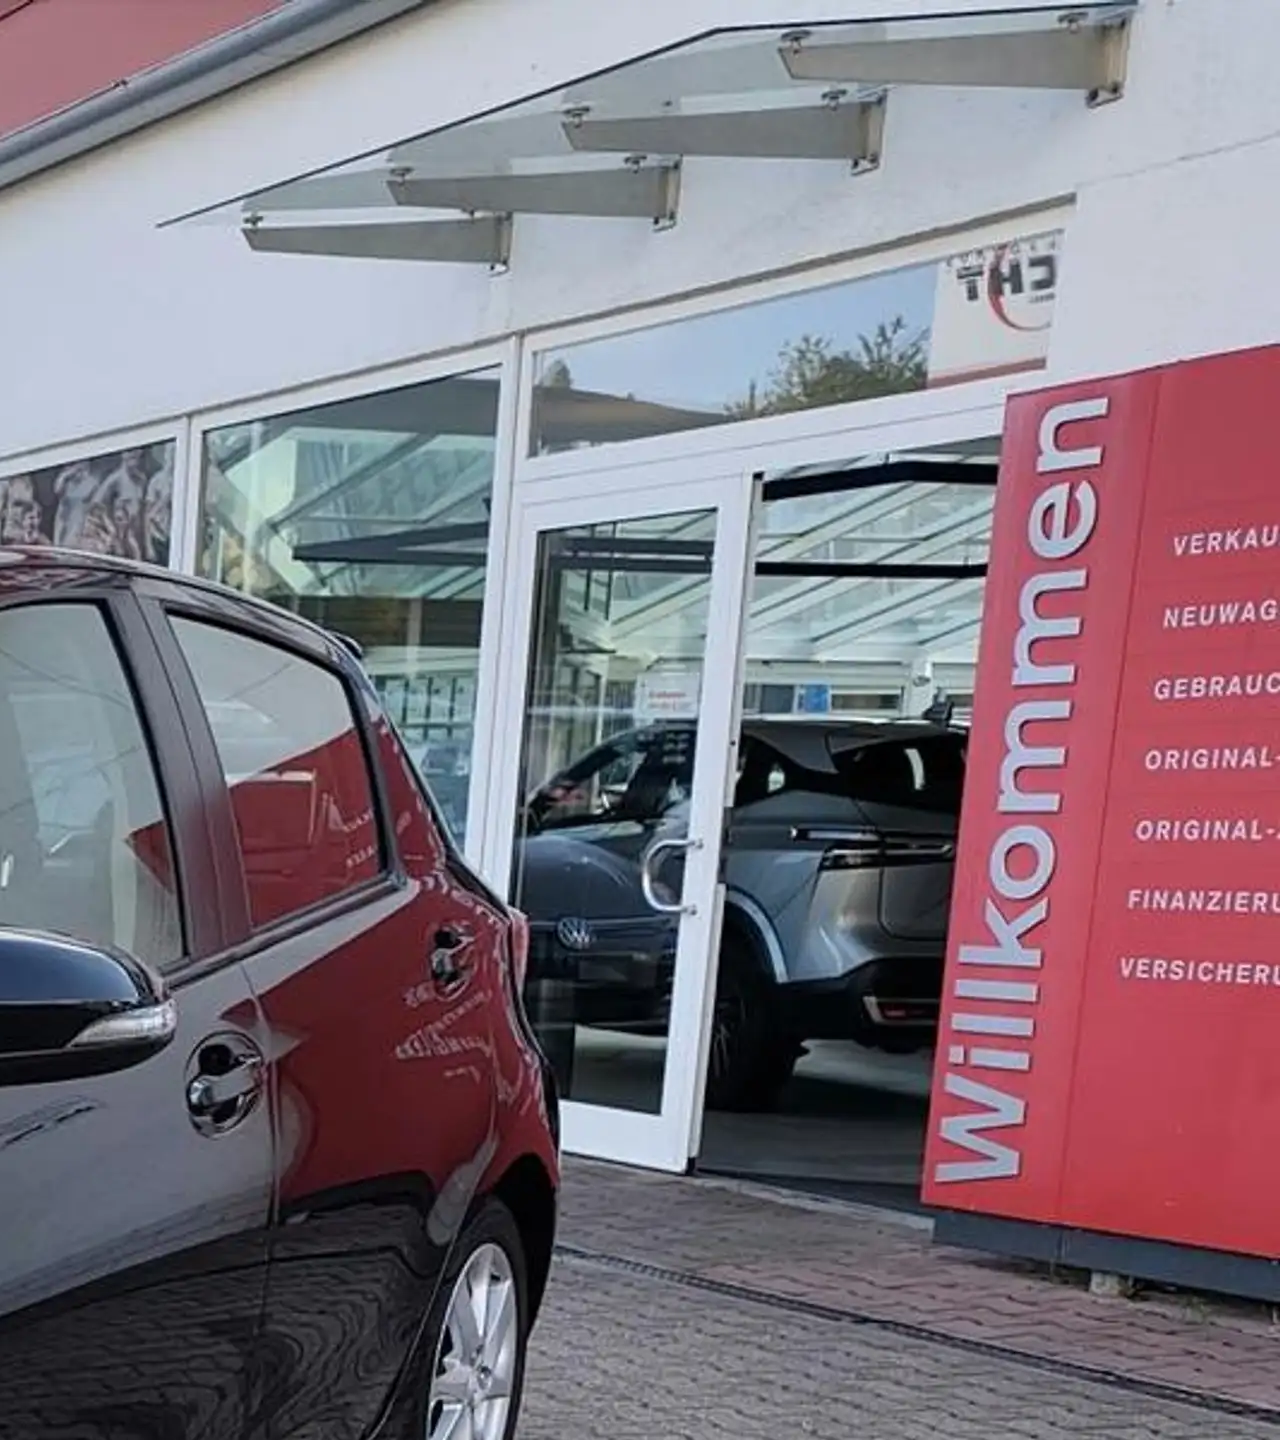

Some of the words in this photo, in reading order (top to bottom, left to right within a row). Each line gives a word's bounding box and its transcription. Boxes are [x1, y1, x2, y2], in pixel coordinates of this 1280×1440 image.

[1173, 525, 1278, 556] VERKAU
[1163, 599, 1277, 629] NEUWAG
[1153, 671, 1280, 701] GEBRAUC
[934, 396, 1110, 1184] Willkommen
[1135, 818, 1280, 841] ORIGINAL-
